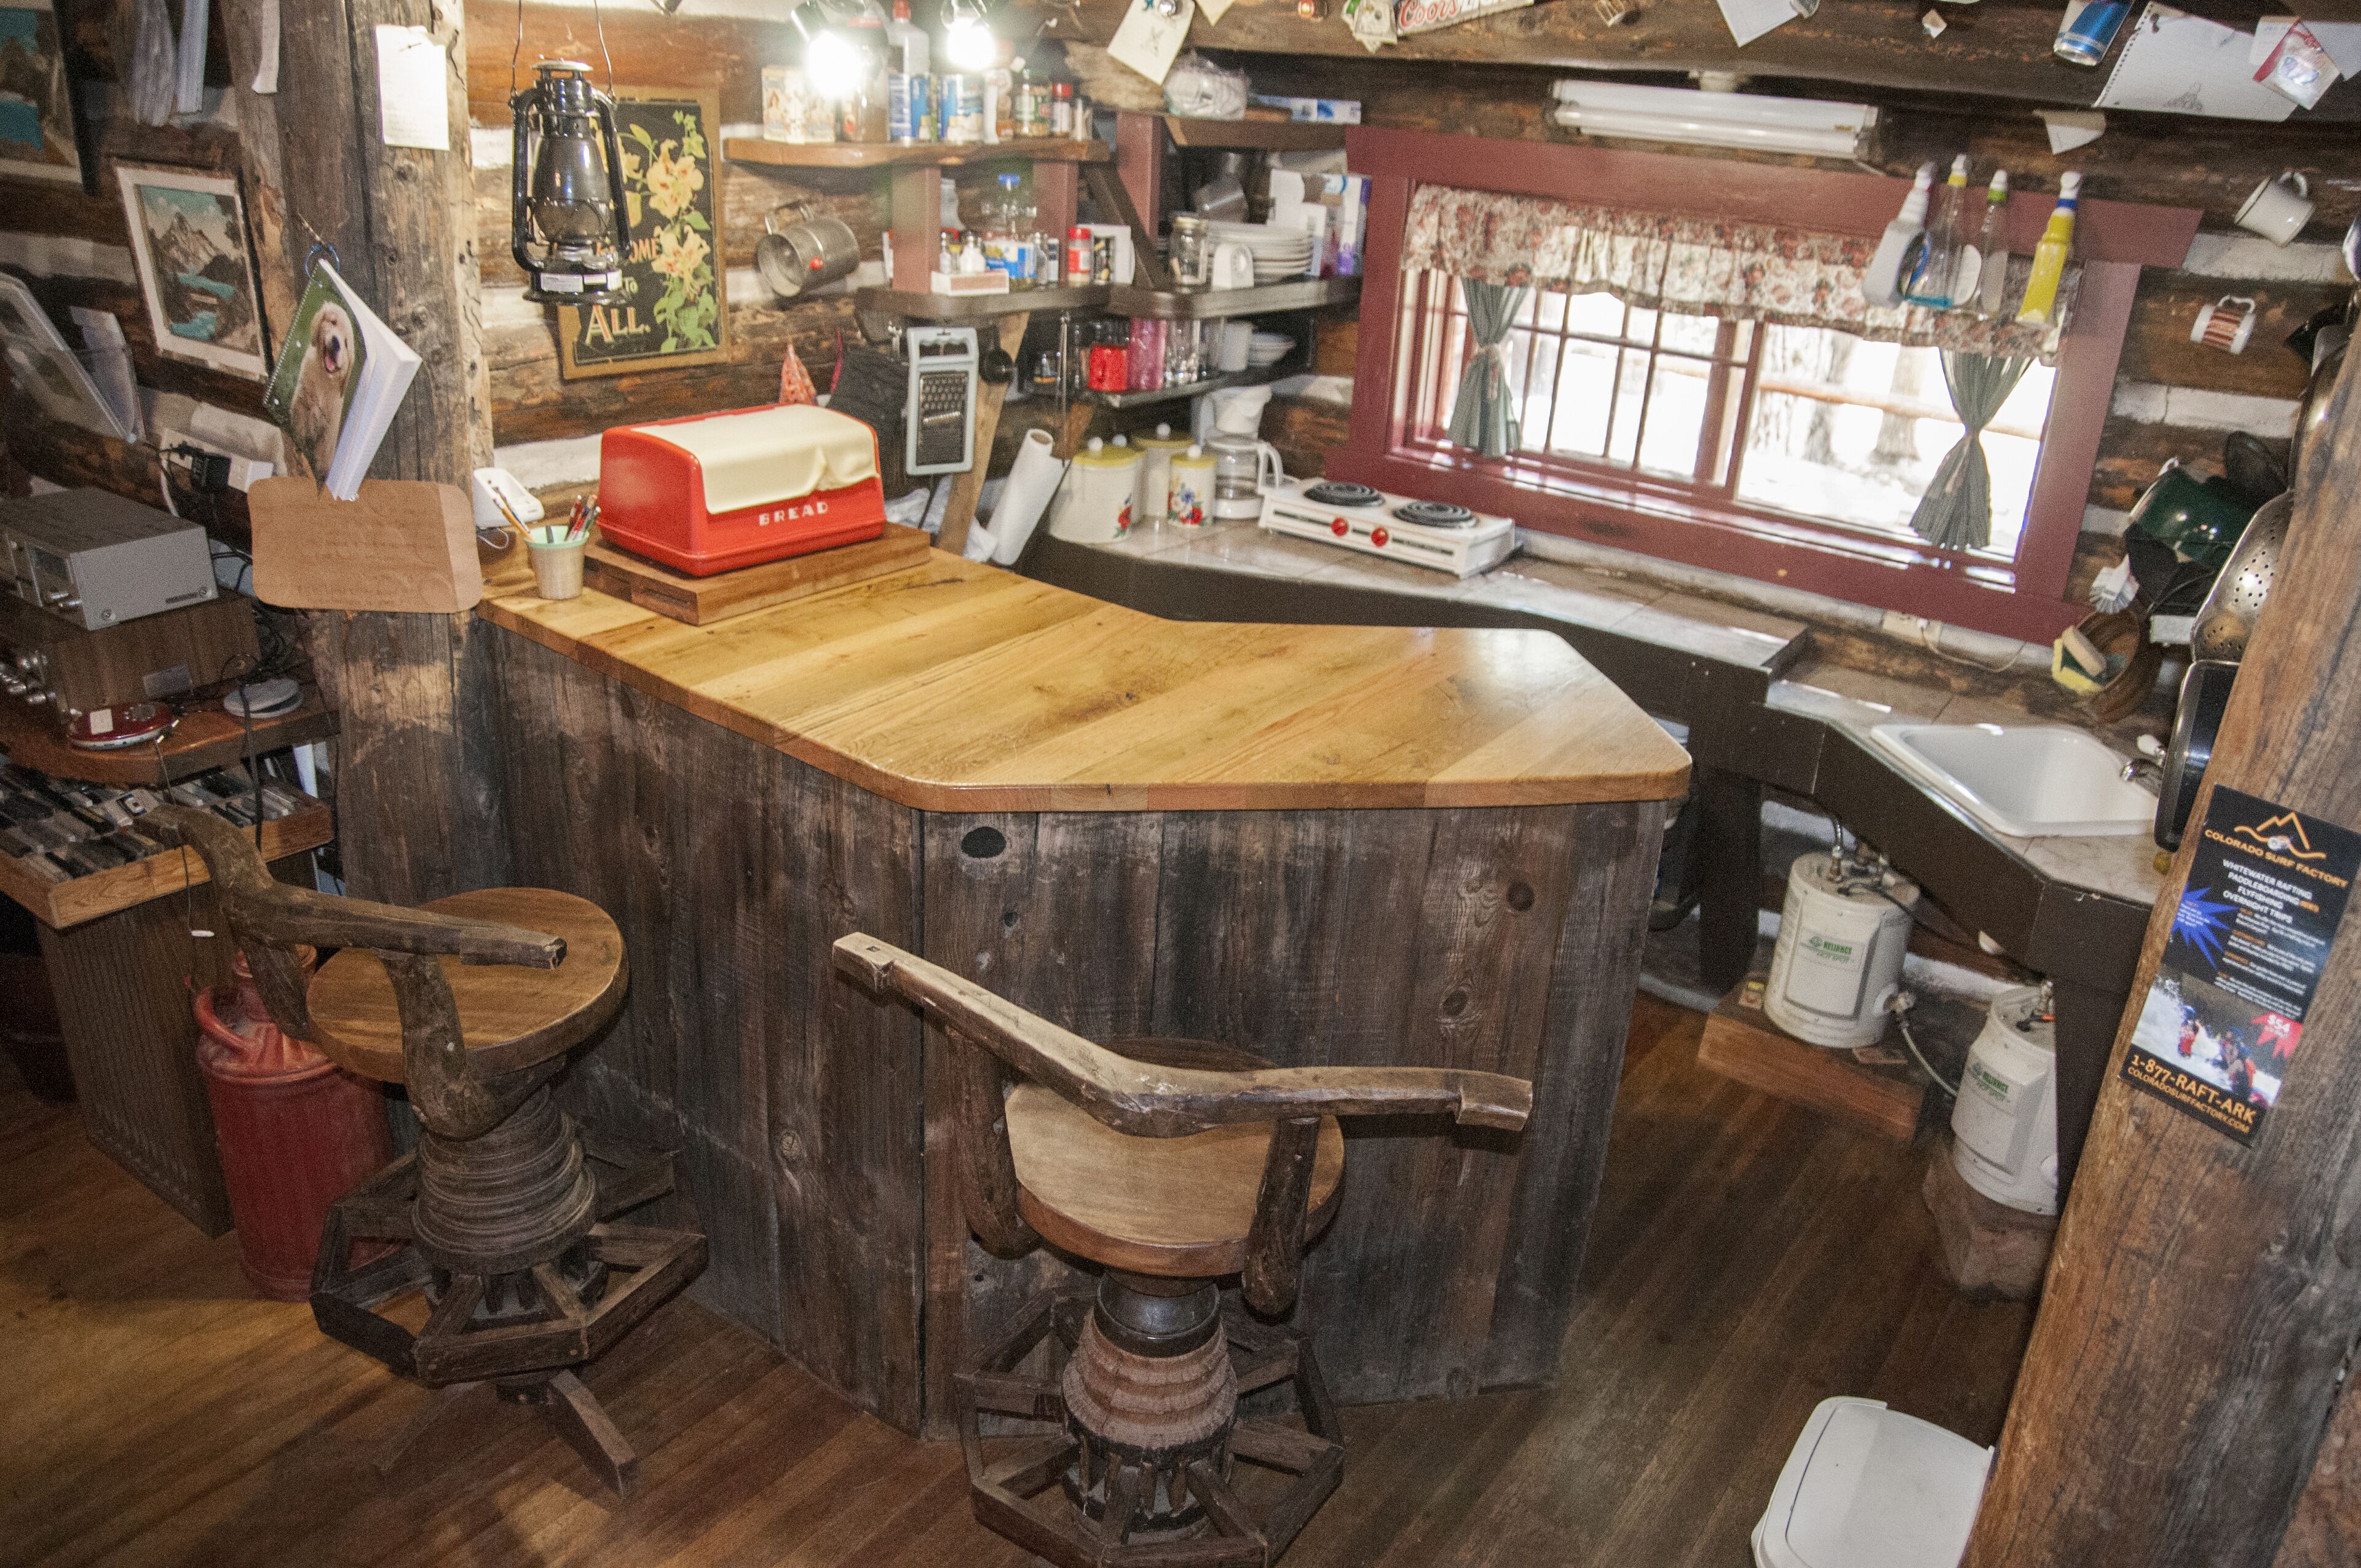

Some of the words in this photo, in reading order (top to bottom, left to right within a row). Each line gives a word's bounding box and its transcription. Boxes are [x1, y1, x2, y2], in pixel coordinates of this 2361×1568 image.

[759, 501, 829, 527] BREAD
[2205, 829, 2264, 857] COLORADO
[2265, 851, 2296, 868] SURF
[2296, 862, 2349, 888] FACTORY
[2223, 859, 2276, 885] WHITEWATER
[2276, 880, 2313, 900] RAFTING
[2228, 871, 2300, 906] PADDLEBOARDING
[2237, 885, 2284, 909] FLYFISHING
[2223, 890, 2270, 914] OVERNIGHT
[2270, 908, 2293, 924] TRIPS
[2130, 1054, 2257, 1125] 1-877-RAFT-ARK
